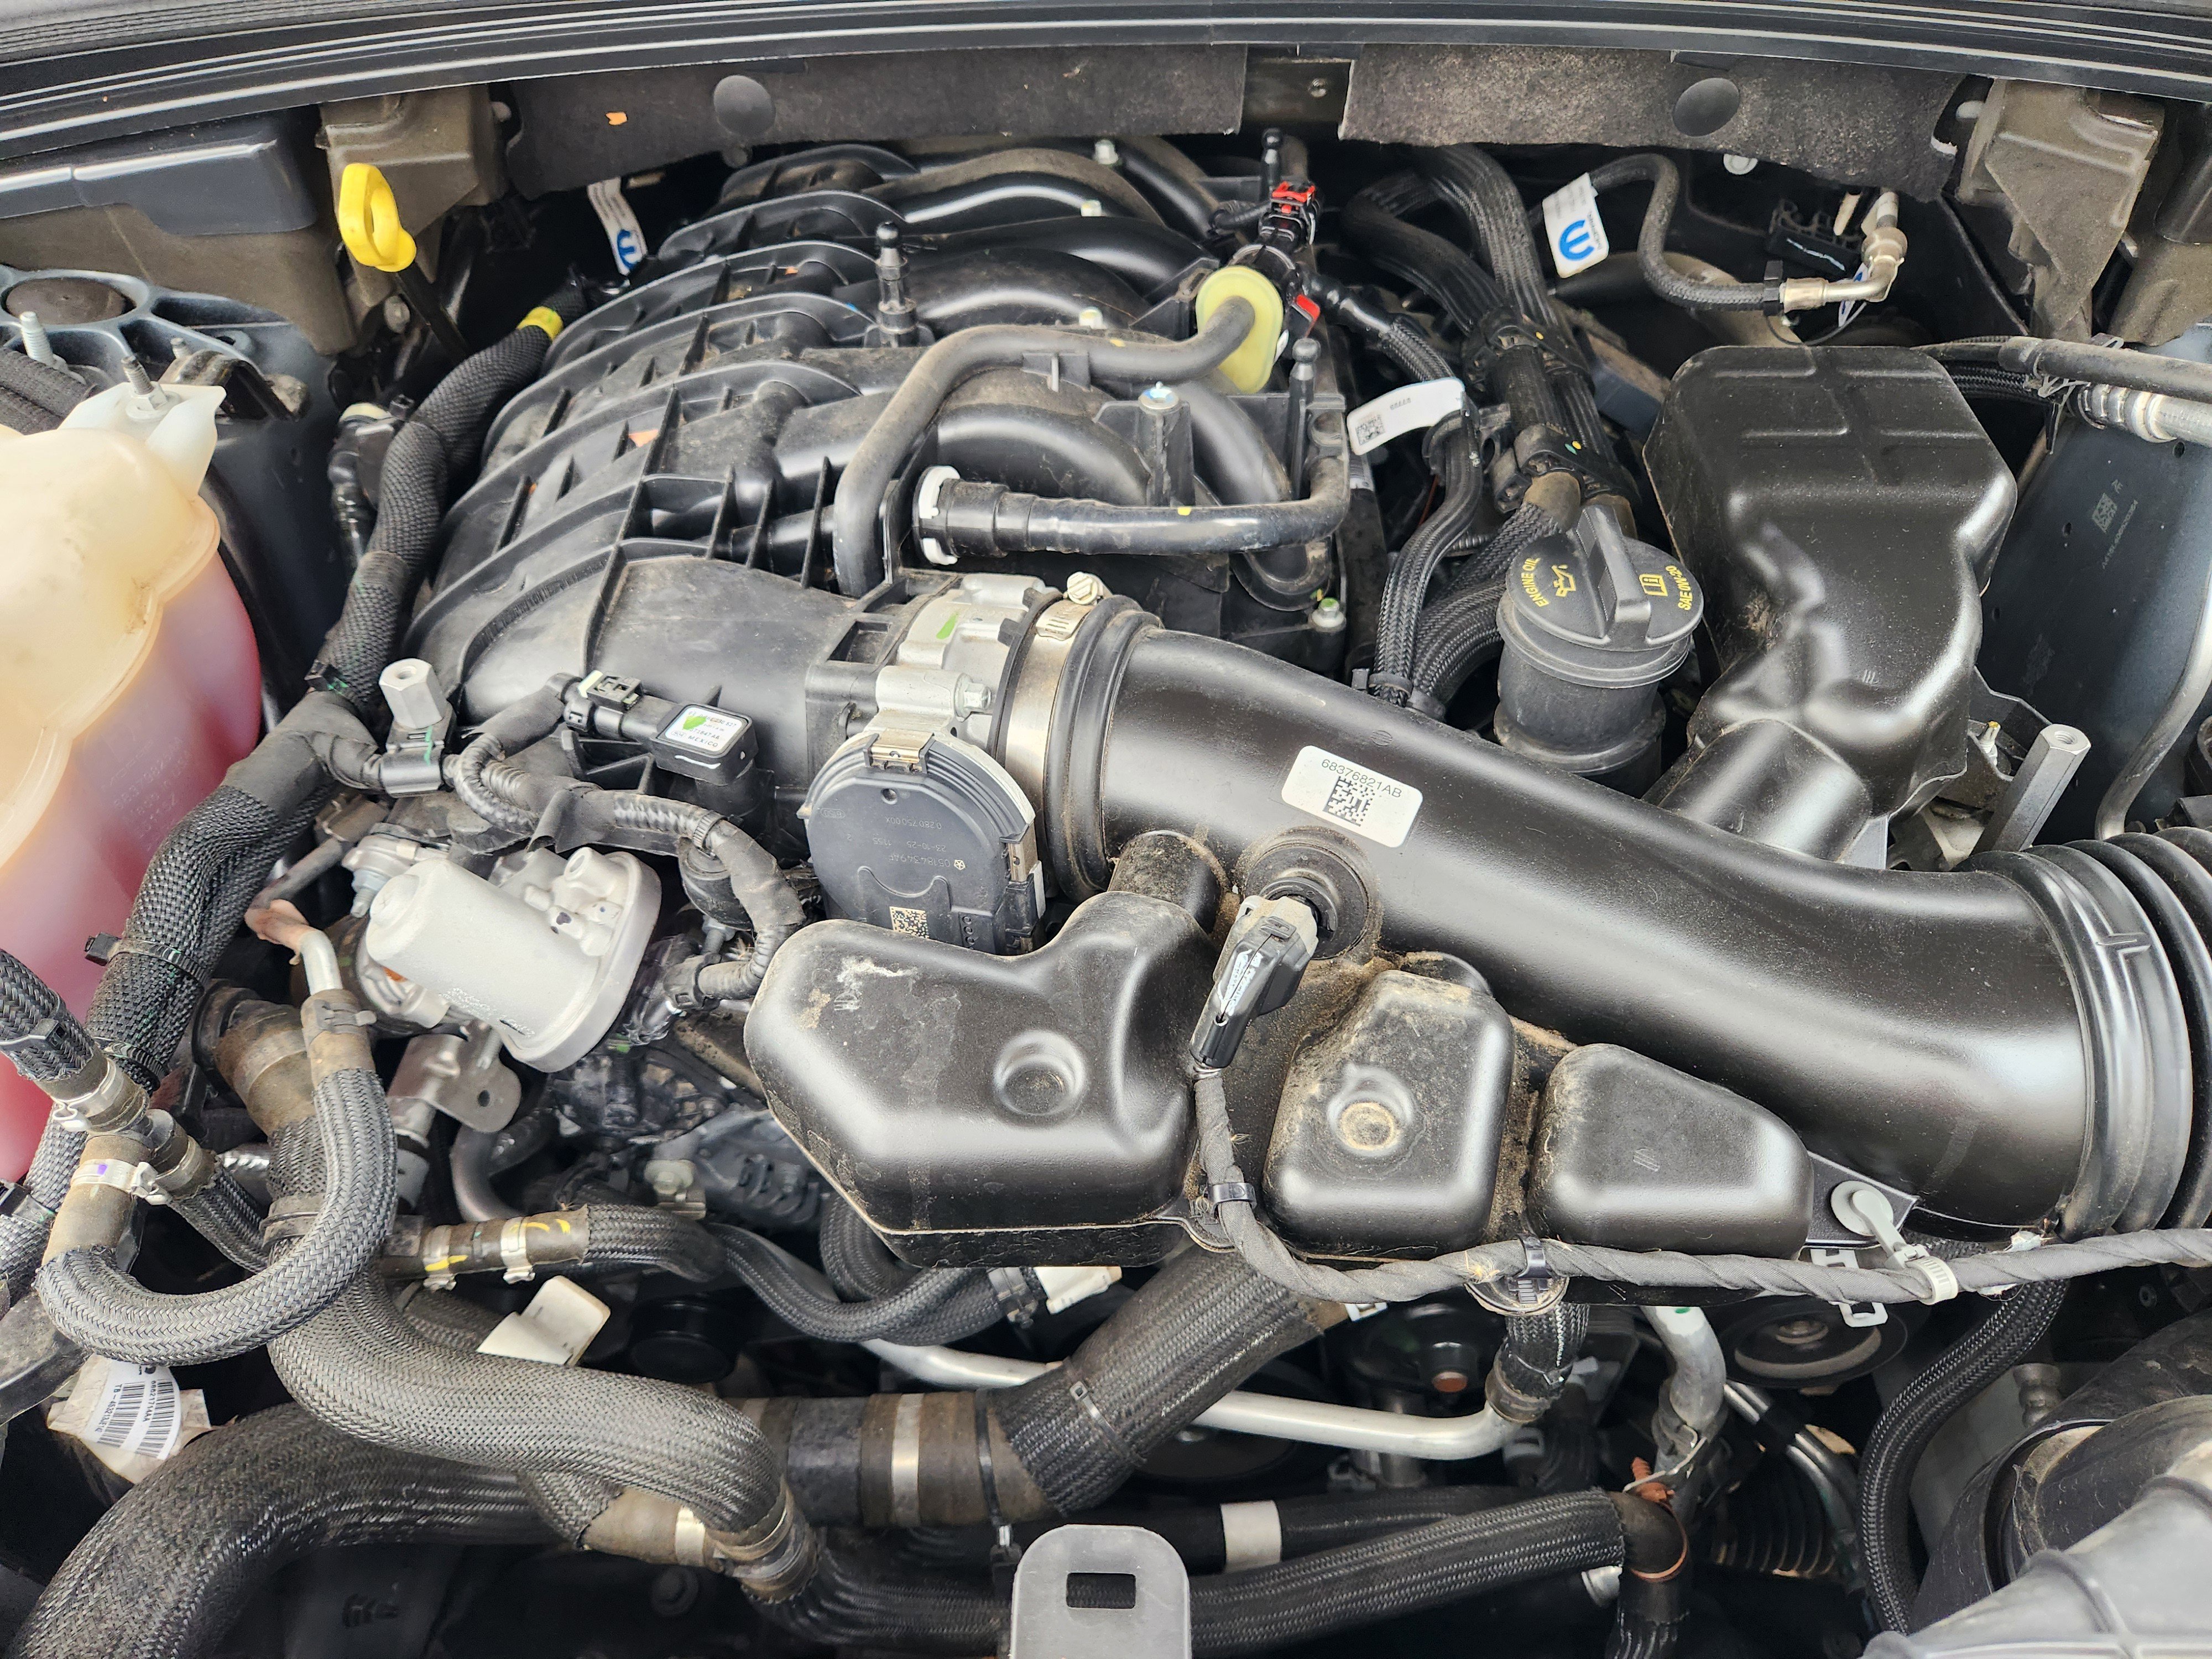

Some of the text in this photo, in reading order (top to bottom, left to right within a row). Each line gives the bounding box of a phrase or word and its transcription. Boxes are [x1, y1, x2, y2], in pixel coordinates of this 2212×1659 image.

[1521, 557, 1549, 607] ENGINE OIL
[1665, 565, 1693, 611] SAE 0W-20
[688, 735, 718, 747] MEXICO
[1321, 759, 1402, 798] 68376821AB
